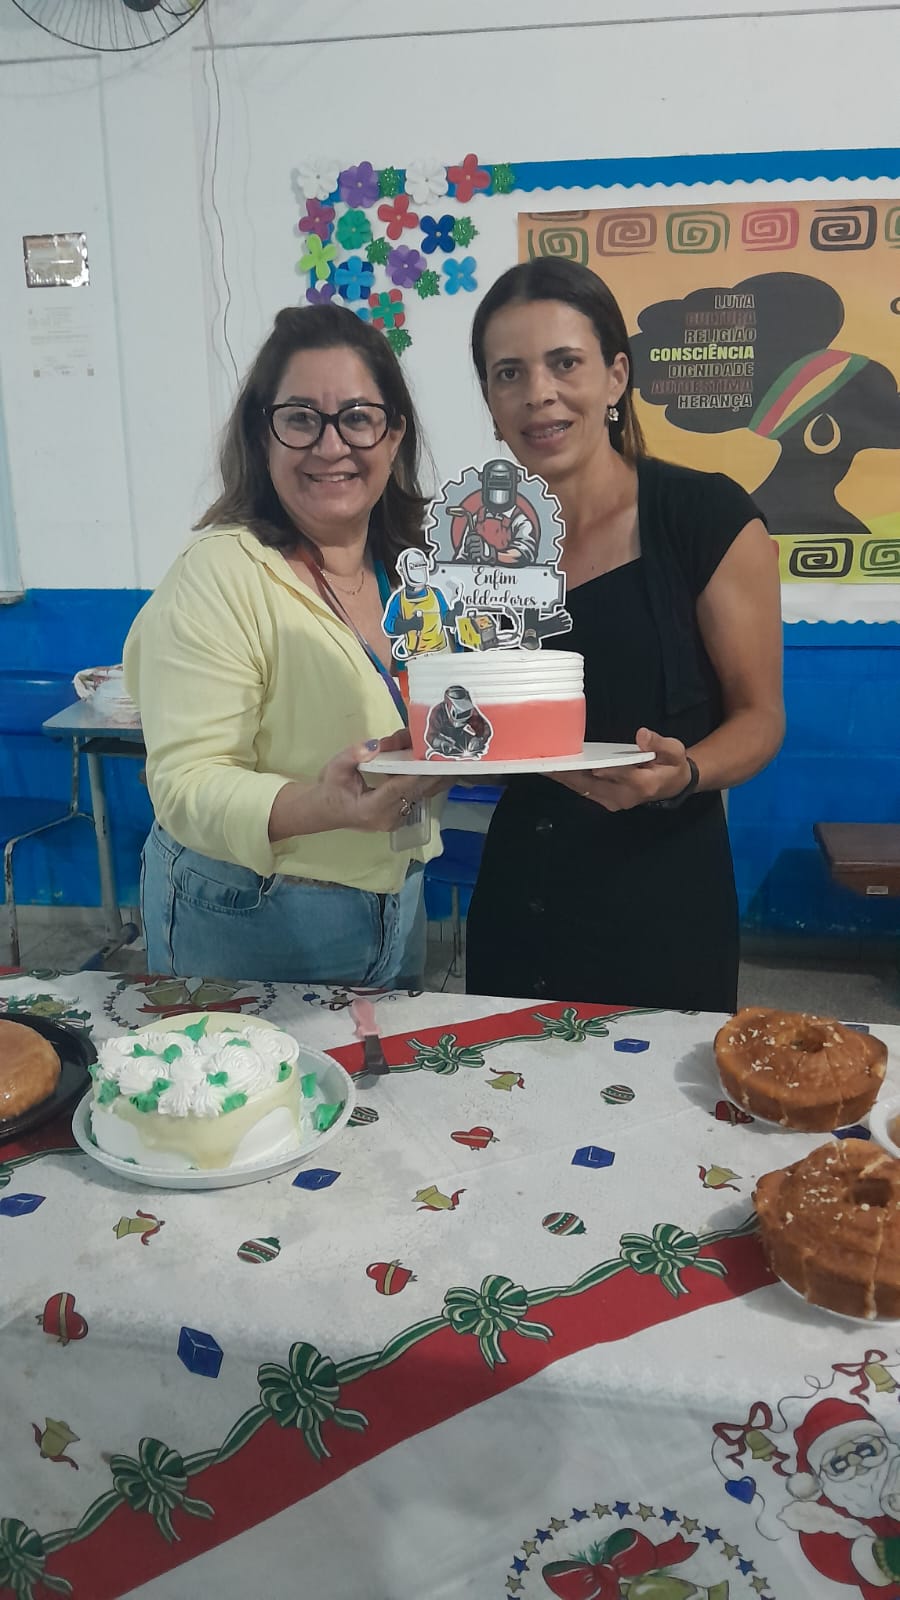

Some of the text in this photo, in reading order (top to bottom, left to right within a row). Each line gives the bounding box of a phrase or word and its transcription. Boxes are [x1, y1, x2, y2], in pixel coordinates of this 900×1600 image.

[714, 294, 755, 310] LUTA
[684, 326, 757, 344] RELIGIÃO
[650, 343, 755, 362] CONSCIÊNCIA
[668, 362, 754, 378] DIGNIDADE
[678, 394, 753, 412] HERANÇA
[472, 565, 517, 590] Enfim
